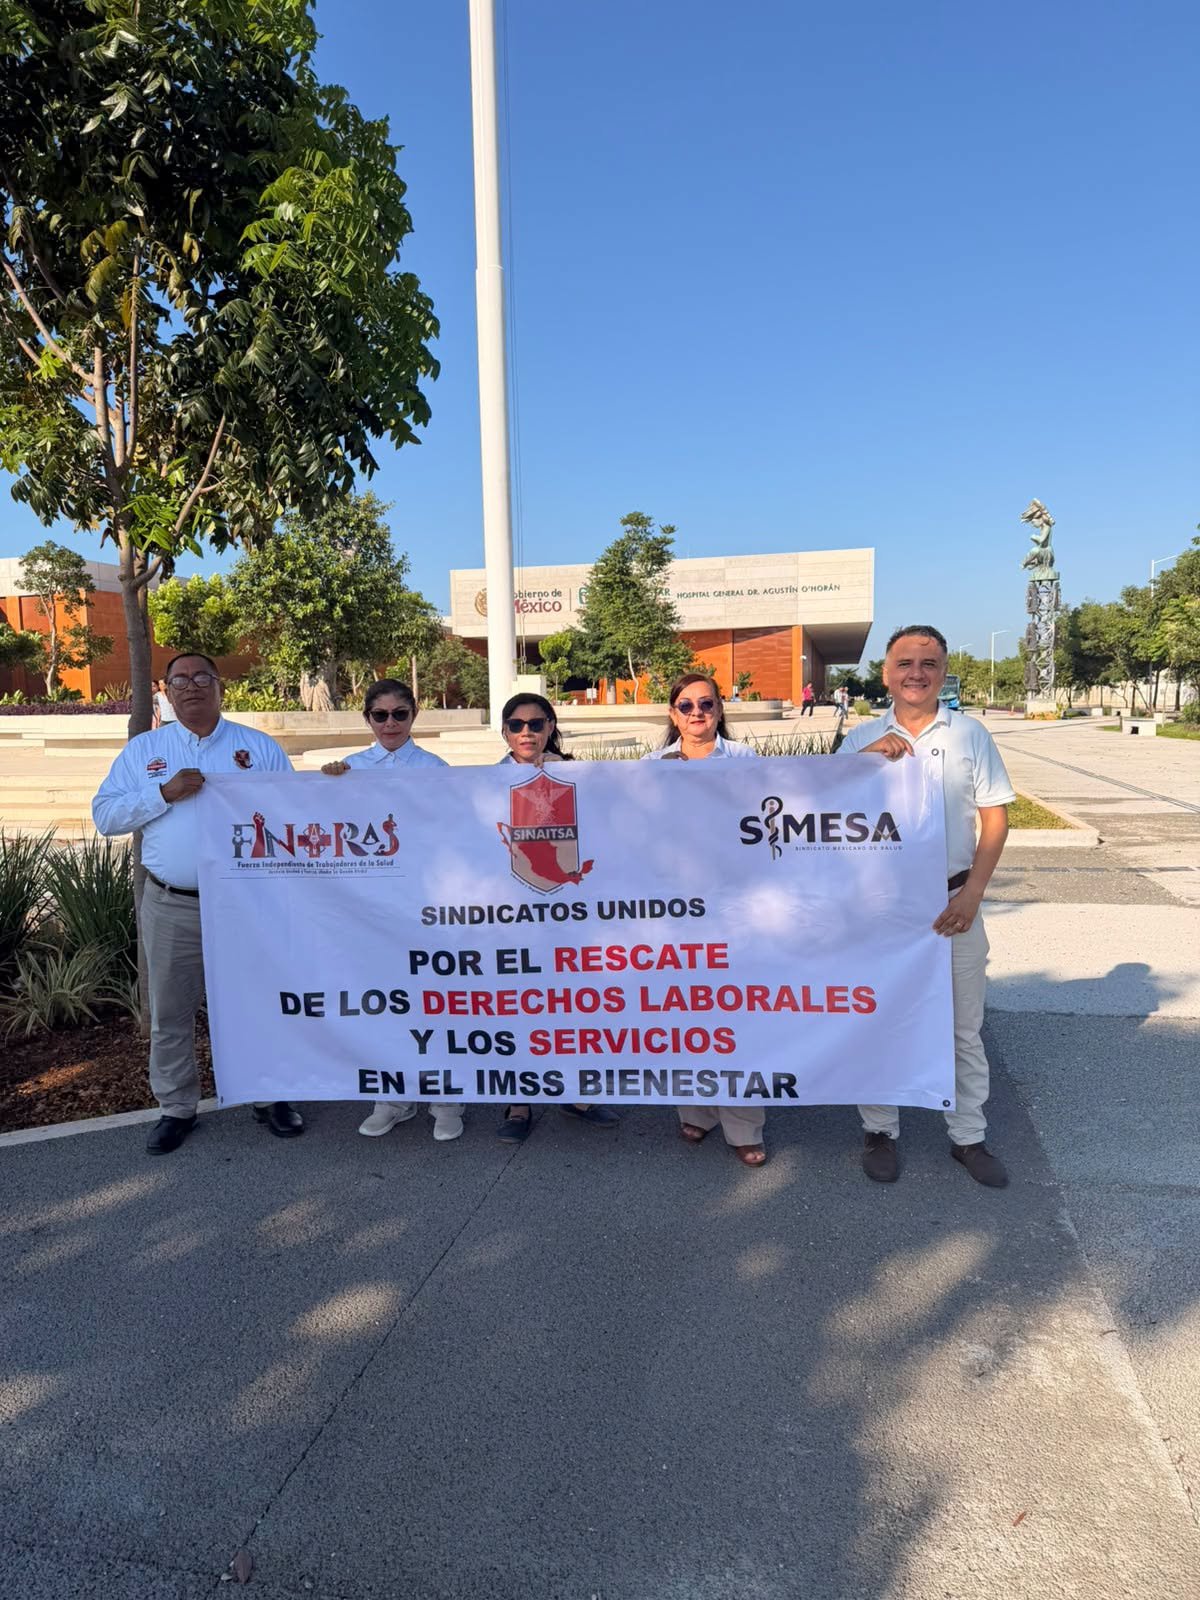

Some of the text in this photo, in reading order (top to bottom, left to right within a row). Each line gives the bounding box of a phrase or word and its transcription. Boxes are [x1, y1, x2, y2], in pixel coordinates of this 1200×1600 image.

[513, 588, 562, 599] obierno de
[677, 591, 710, 599] HOSPITAL
[713, 589, 744, 597] GENERAL
[747, 588, 760, 596] DR.
[763, 586, 798, 595] AGUSTÍN
[513, 827, 575, 841] SINAITSA
[739, 796, 902, 860] SIMESA
[262, 860, 306, 870] Independiente
[315, 860, 357, 869] Trabajadores
[368, 859, 374, 867] la
[375, 859, 394, 867] Salud
[421, 897, 706, 926] SINDICATOS UNIDOS
[409, 943, 730, 976] POR EL RESCATE
[279, 984, 878, 1018] DE LOS DERECHOS LABORALES
[409, 1026, 737, 1056] Y LOS SERVICIOS
[358, 1068, 800, 1099] EN EL IMSS BIENESTAR
